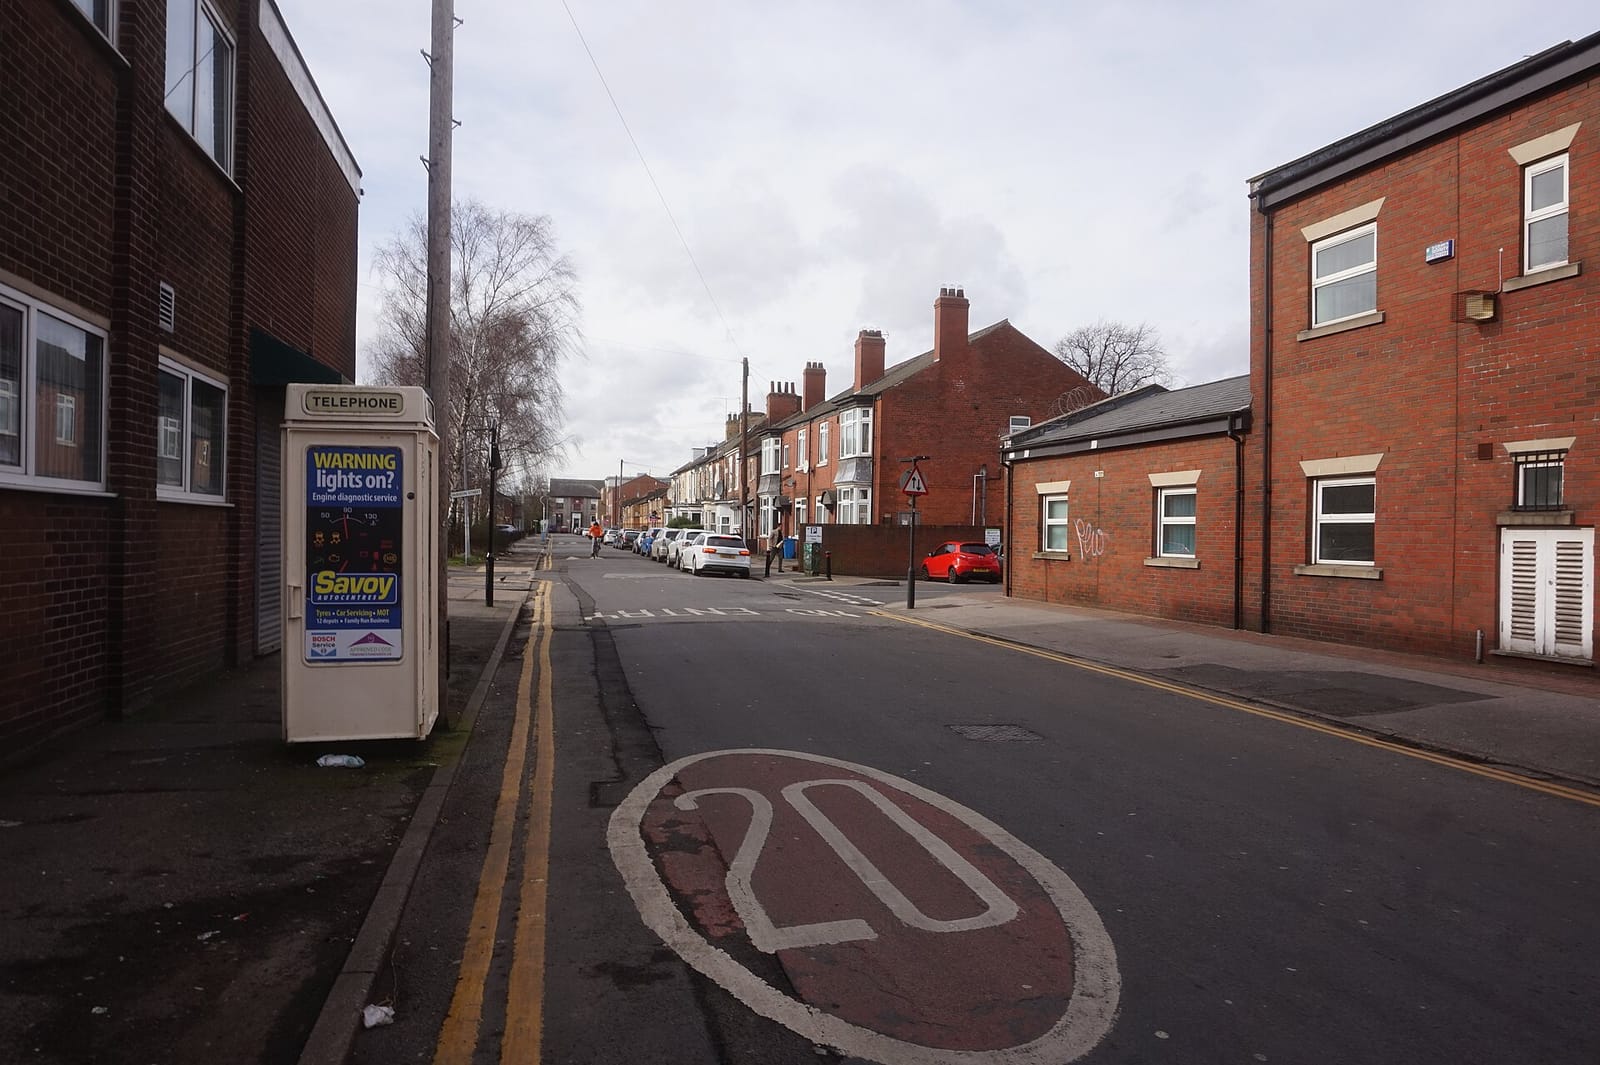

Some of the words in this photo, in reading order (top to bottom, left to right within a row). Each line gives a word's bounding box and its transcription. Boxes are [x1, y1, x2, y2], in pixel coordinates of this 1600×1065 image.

[312, 396, 398, 409] TELEPHONE
[313, 452, 396, 470] WARNING
[316, 470, 363, 492] lights
[365, 471, 395, 489] on?
[312, 492, 336, 503] Engine
[337, 492, 374, 503] diagnostic
[373, 494, 398, 502] service
[315, 570, 394, 600] Savoy
[316, 609, 331, 617] Tyres
[346, 609, 373, 618] Servicing
[583, 607, 761, 620] ENTRY
[673, 778, 1021, 954] 20
